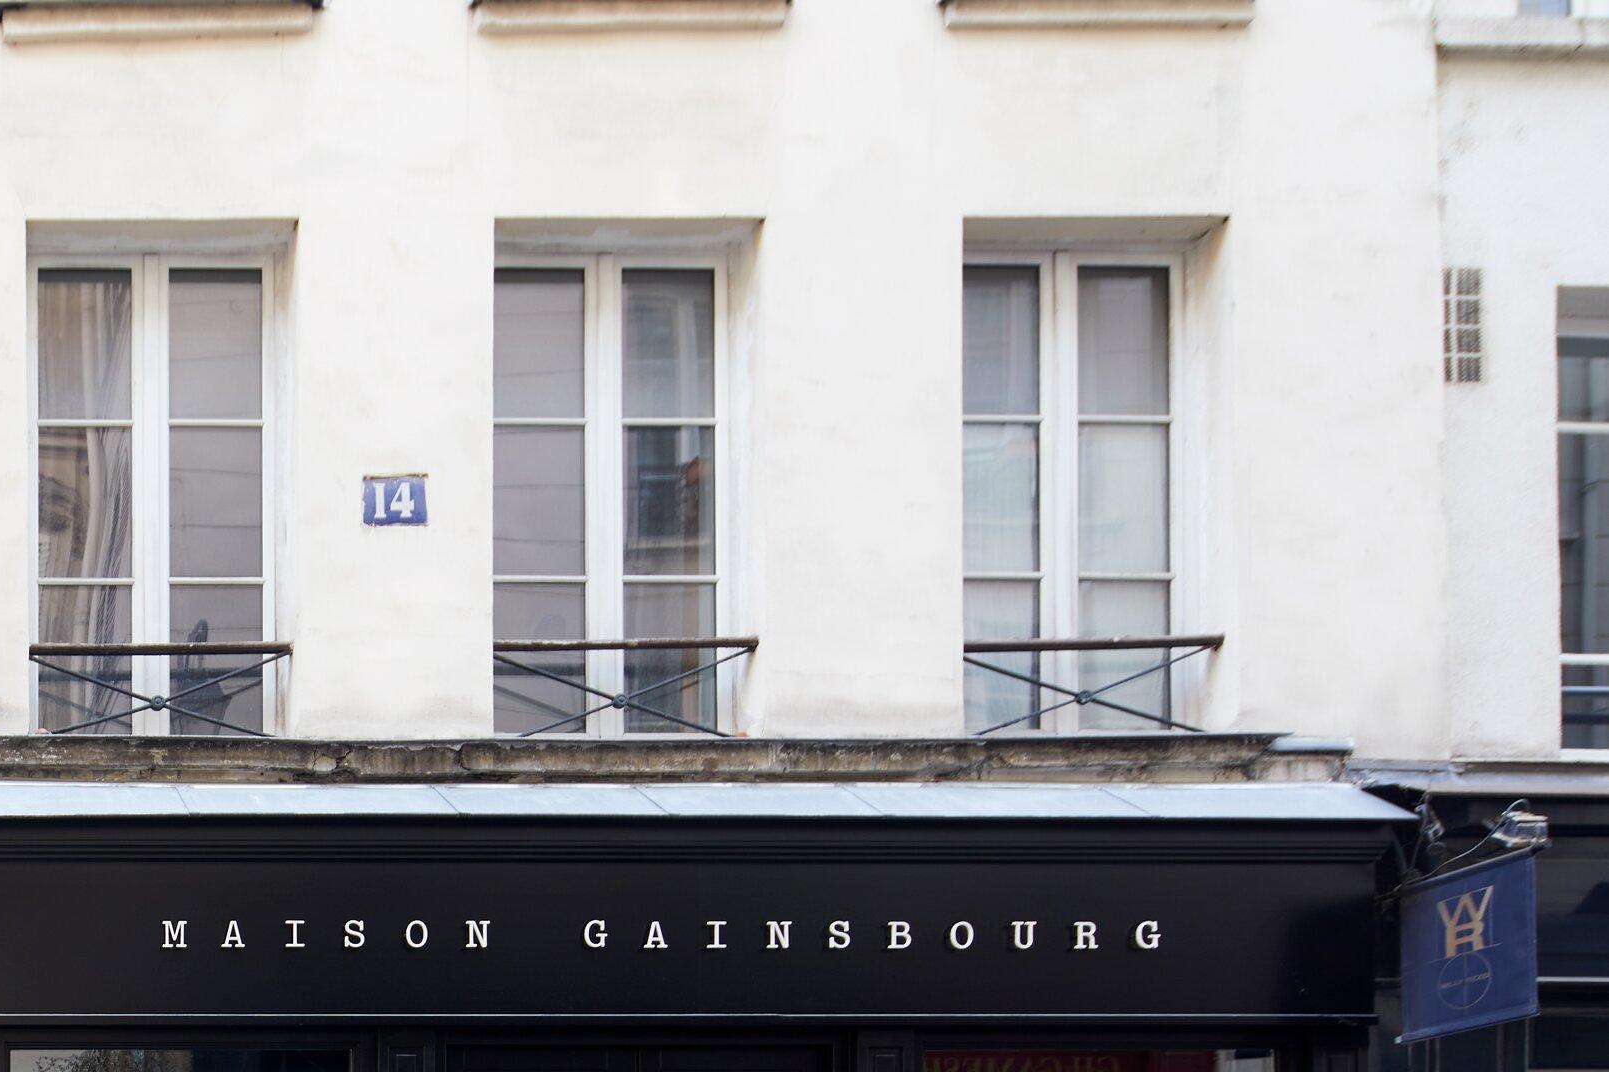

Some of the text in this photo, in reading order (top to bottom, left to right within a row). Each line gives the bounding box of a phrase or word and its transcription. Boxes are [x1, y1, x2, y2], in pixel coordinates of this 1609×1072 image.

[372, 481, 415, 519] 14
[161, 919, 1163, 950] MAISON GAINSBOURG
